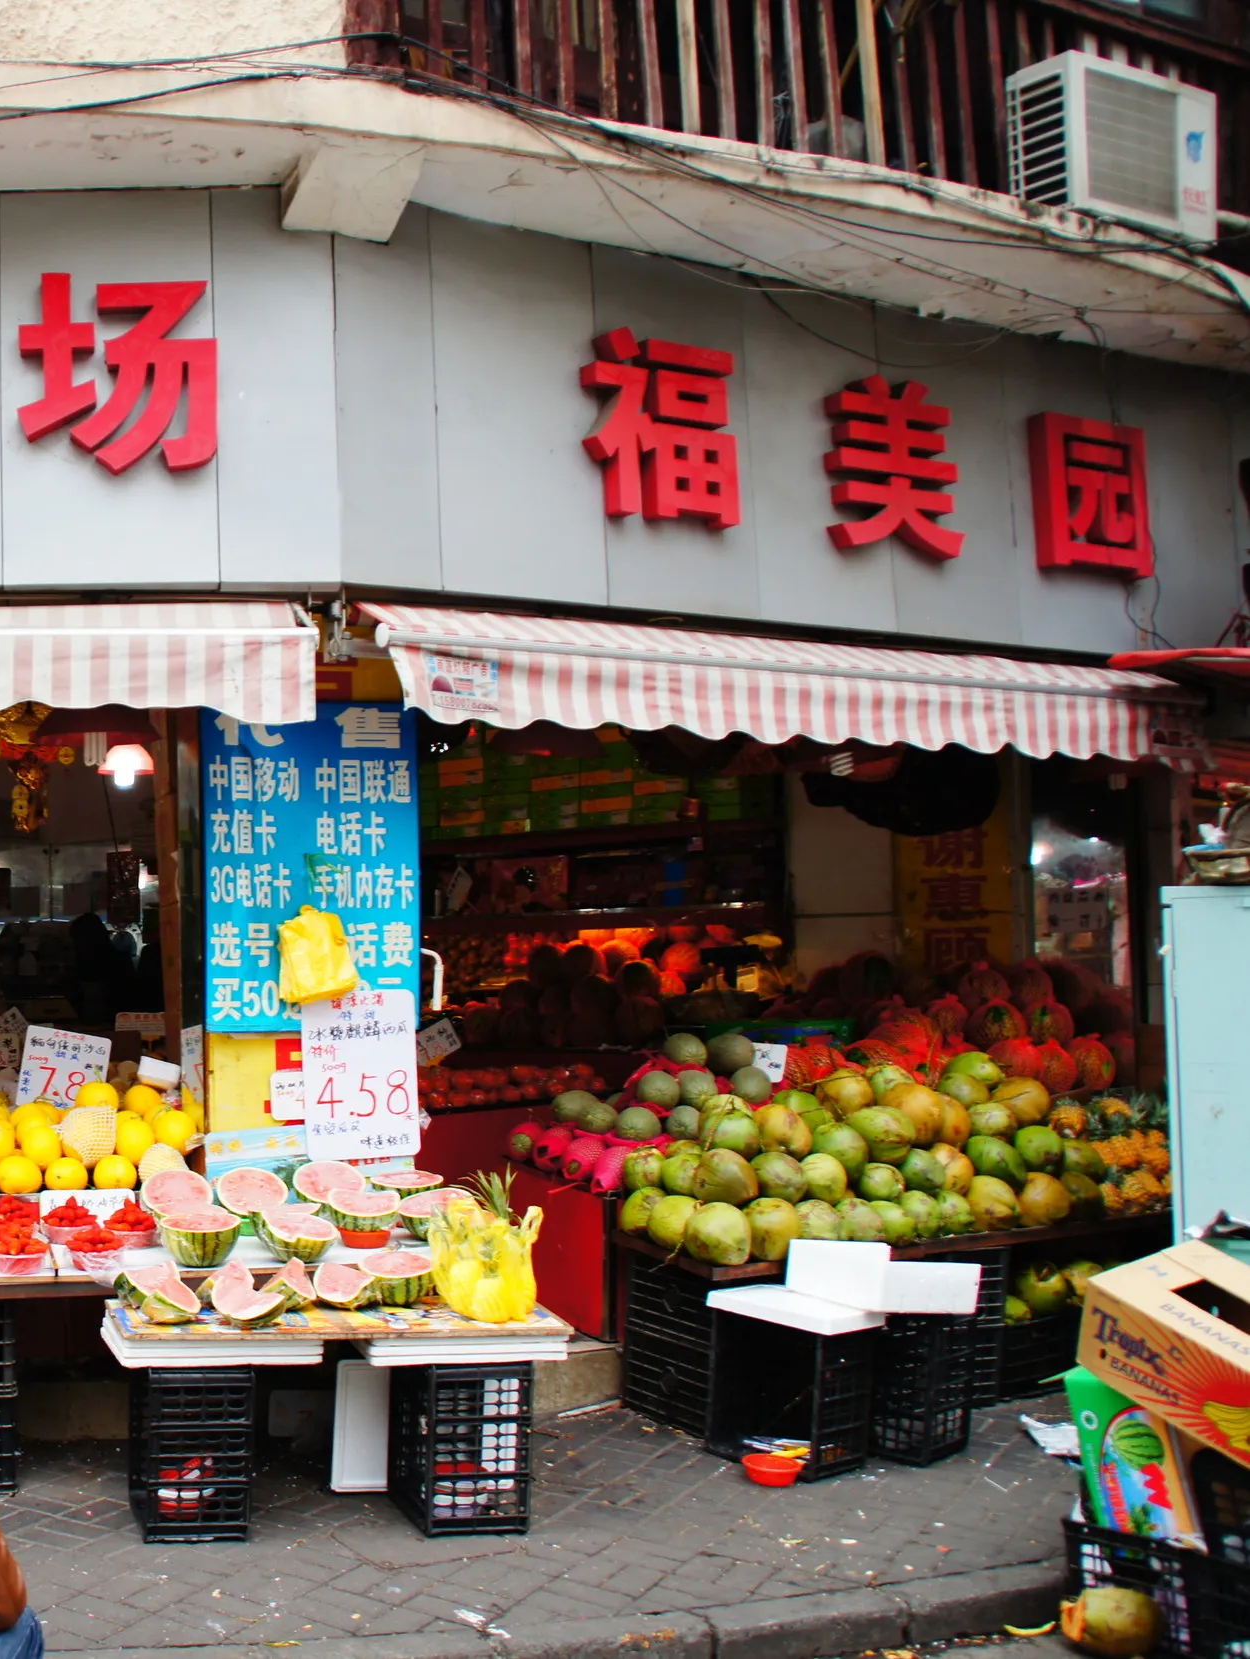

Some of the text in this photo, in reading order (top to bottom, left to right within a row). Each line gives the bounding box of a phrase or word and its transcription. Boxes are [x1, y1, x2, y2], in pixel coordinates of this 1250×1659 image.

[579, 326, 1154, 580] 福美园
[208, 755, 412, 804] 中国移动 中国联通
[210, 808, 387, 856] 充值卡 电话卡
[210, 862, 416, 909] 3G电话卡 手机内存卡
[210, 921, 414, 968] 选号话费
[38, 1065, 86, 1102] 7.8
[316, 1069, 411, 1119] 4.58
[1159, 1303, 1250, 1356] BANANAS
[1110, 1355, 1181, 1405] BANANAS
